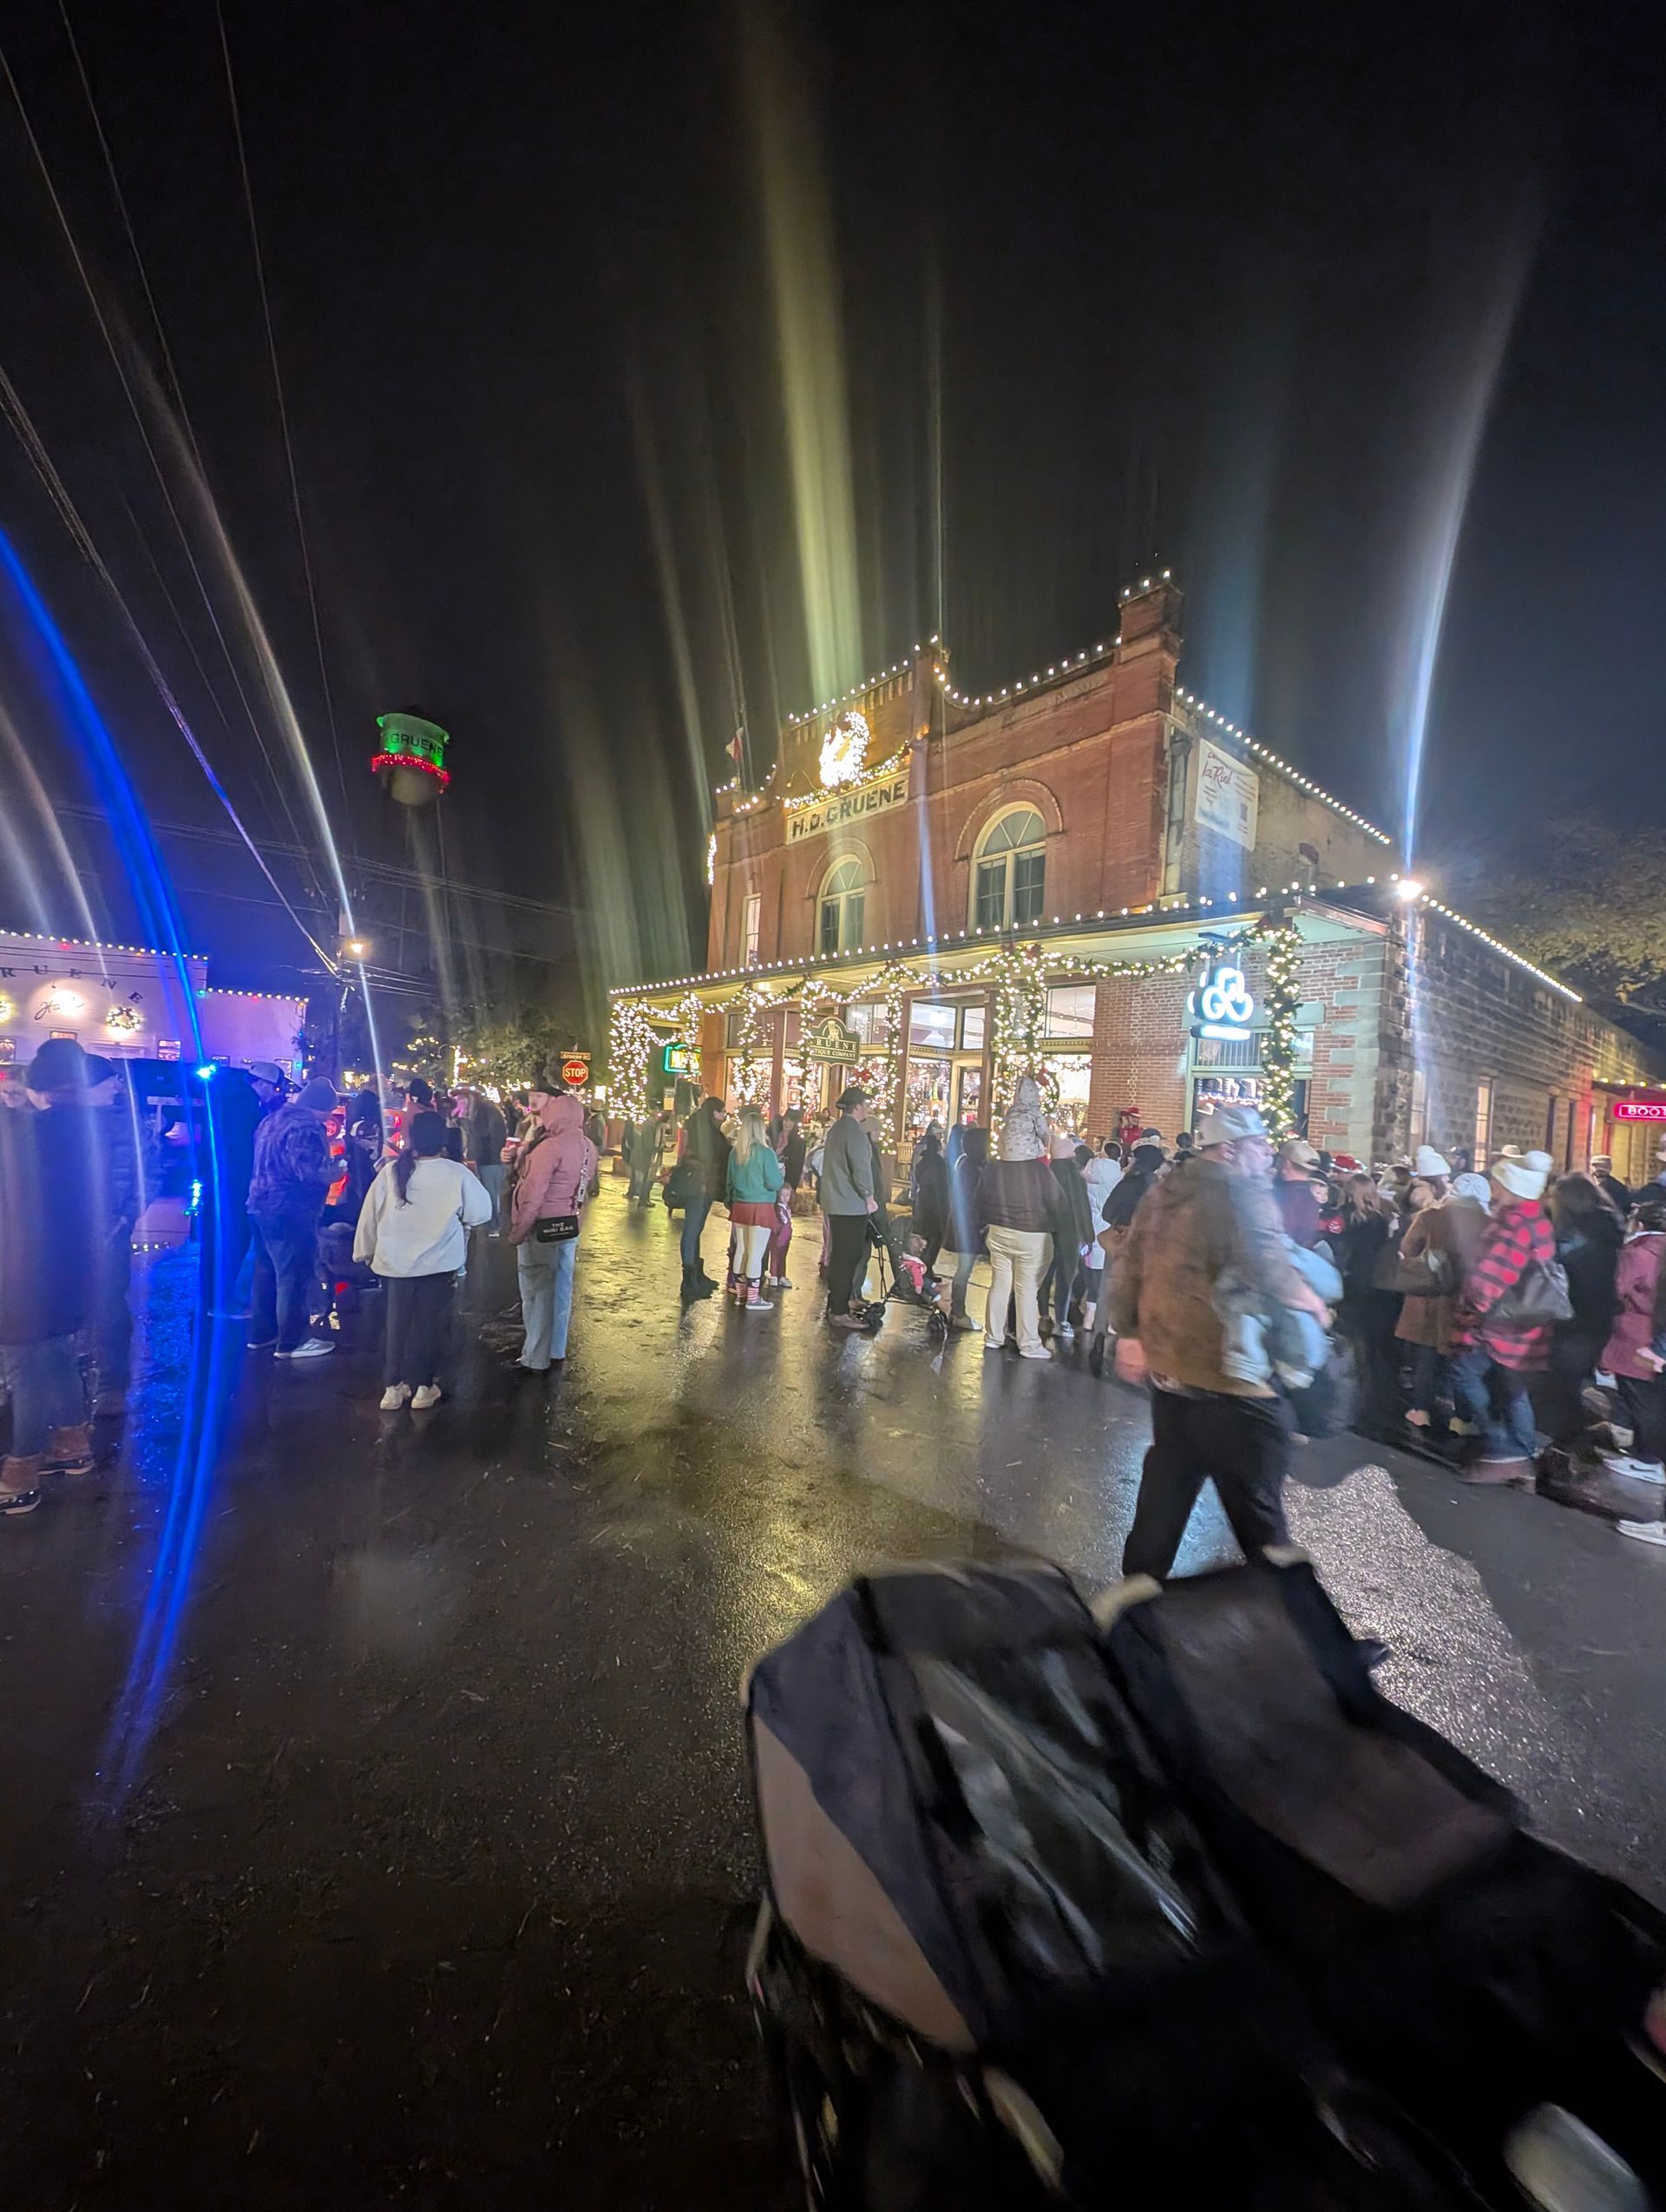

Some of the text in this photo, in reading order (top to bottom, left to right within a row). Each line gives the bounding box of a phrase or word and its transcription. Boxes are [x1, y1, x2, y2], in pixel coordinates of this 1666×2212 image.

[390, 733, 443, 756] GRUENE
[826, 780, 906, 825] GRUENE
[810, 1038, 857, 1050] RUENE
[565, 1068, 587, 1077] STOP
